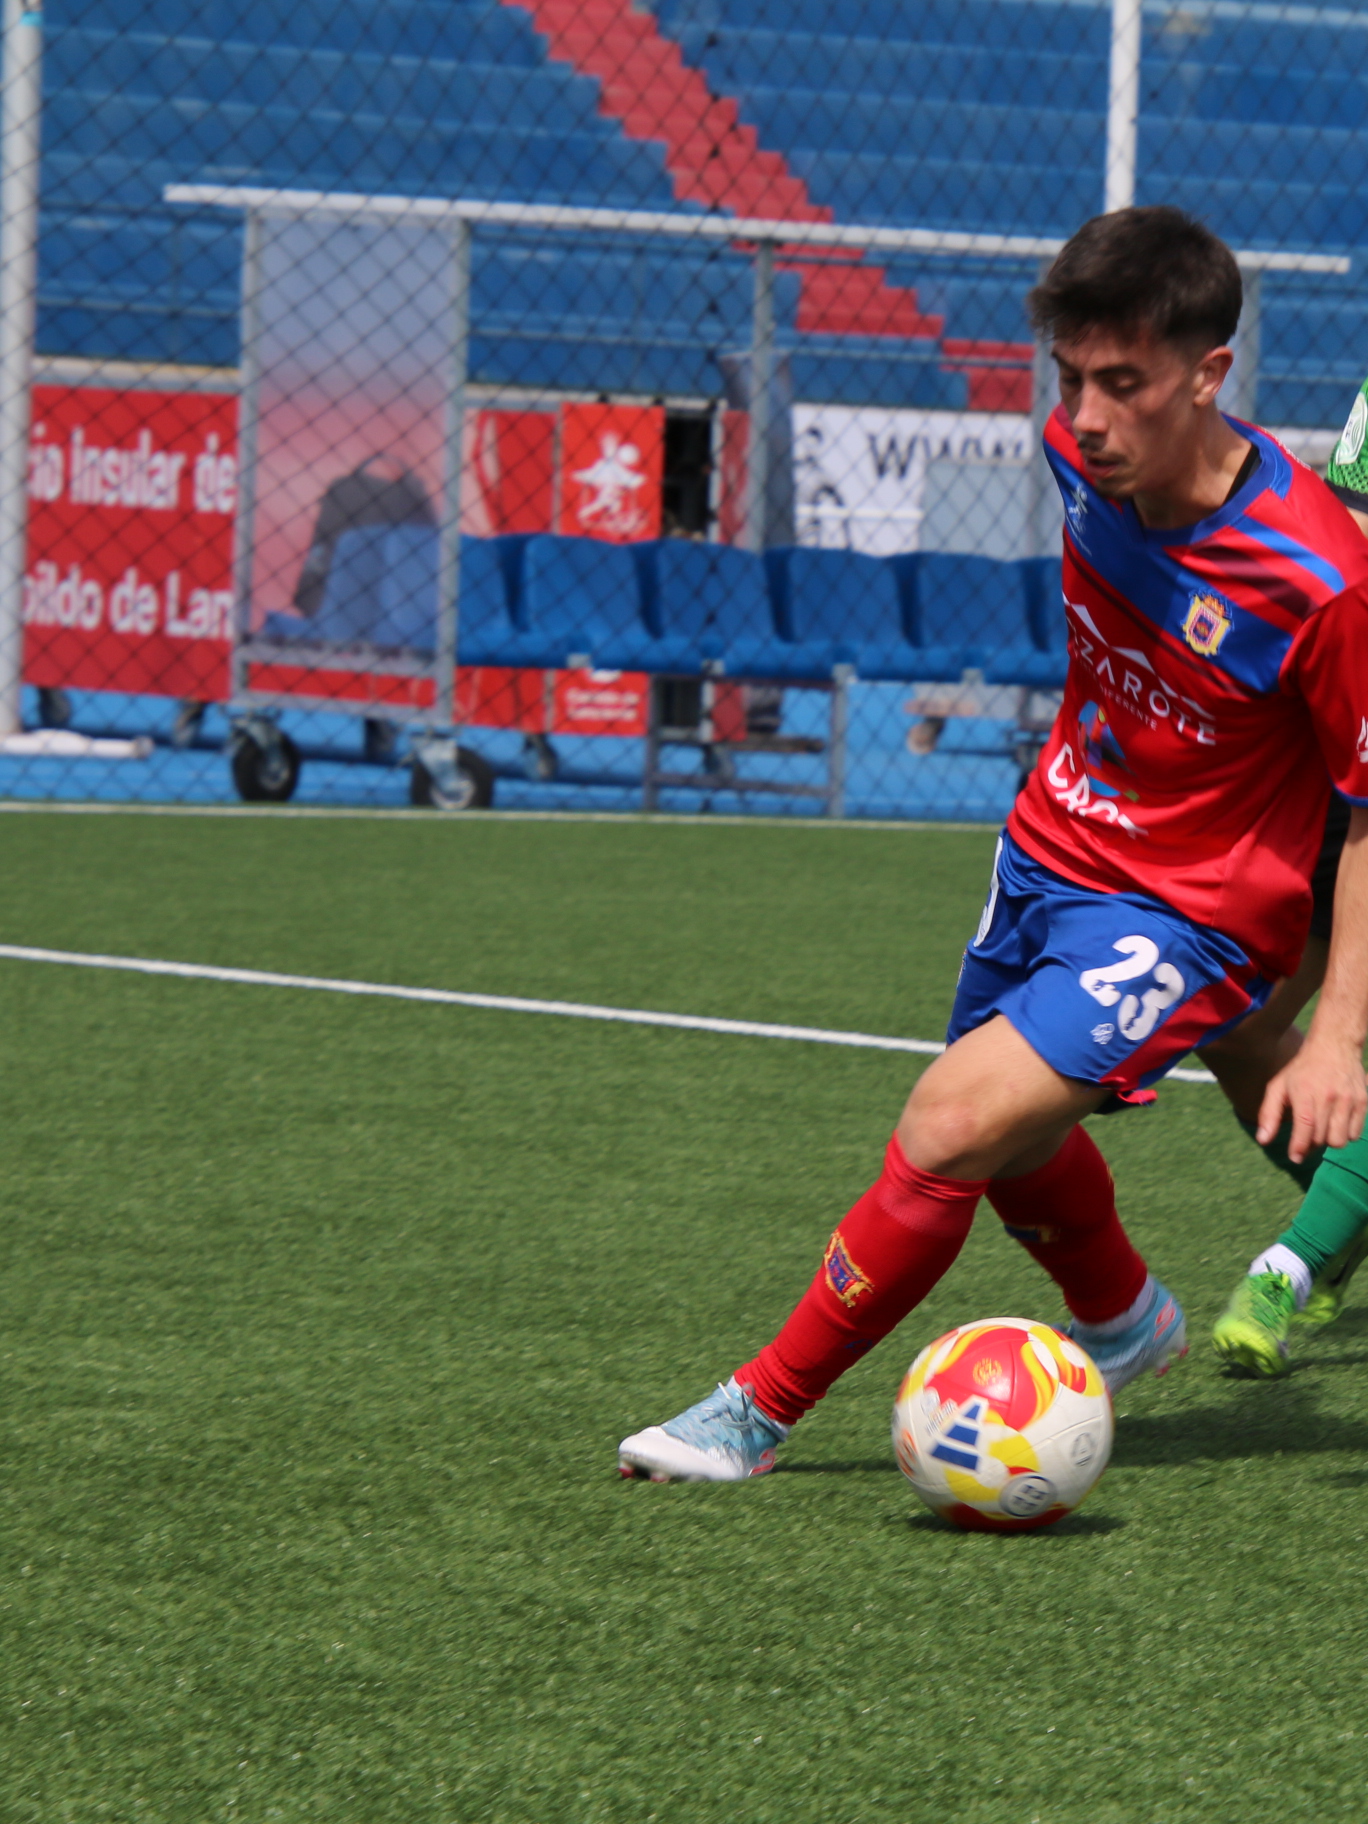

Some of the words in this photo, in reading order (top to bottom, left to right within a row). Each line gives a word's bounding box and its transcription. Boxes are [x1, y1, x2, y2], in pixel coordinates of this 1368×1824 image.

[70, 425, 186, 510] Insular
[194, 432, 237, 513] de
[110, 565, 158, 634] de
[1079, 935, 1185, 1040] 23
